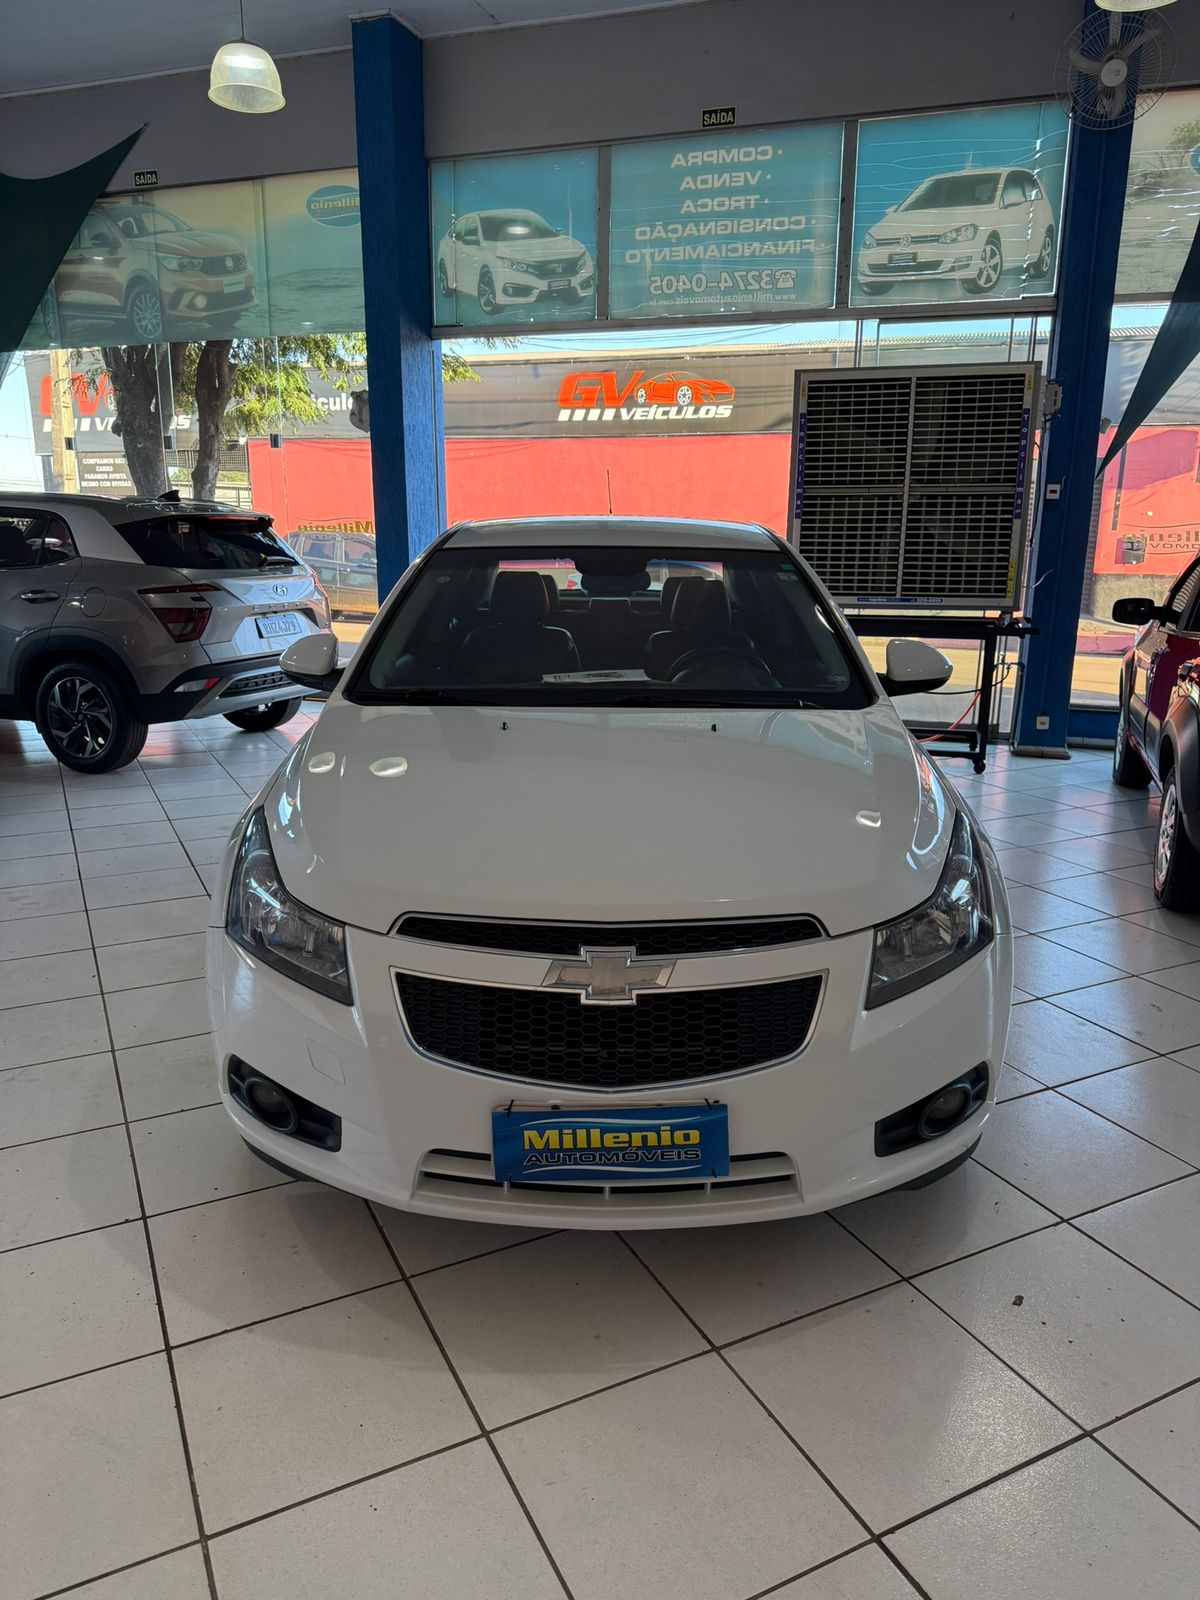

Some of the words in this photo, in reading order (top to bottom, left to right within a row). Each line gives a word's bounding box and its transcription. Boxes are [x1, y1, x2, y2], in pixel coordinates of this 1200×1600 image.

[703, 109, 734, 125] SAÍDA
[556, 369, 645, 407] GV
[620, 404, 734, 421] VEÍCULOS
[523, 1126, 701, 1150] Millenio
[523, 1149, 702, 1166] AUTOMÓVEIS
